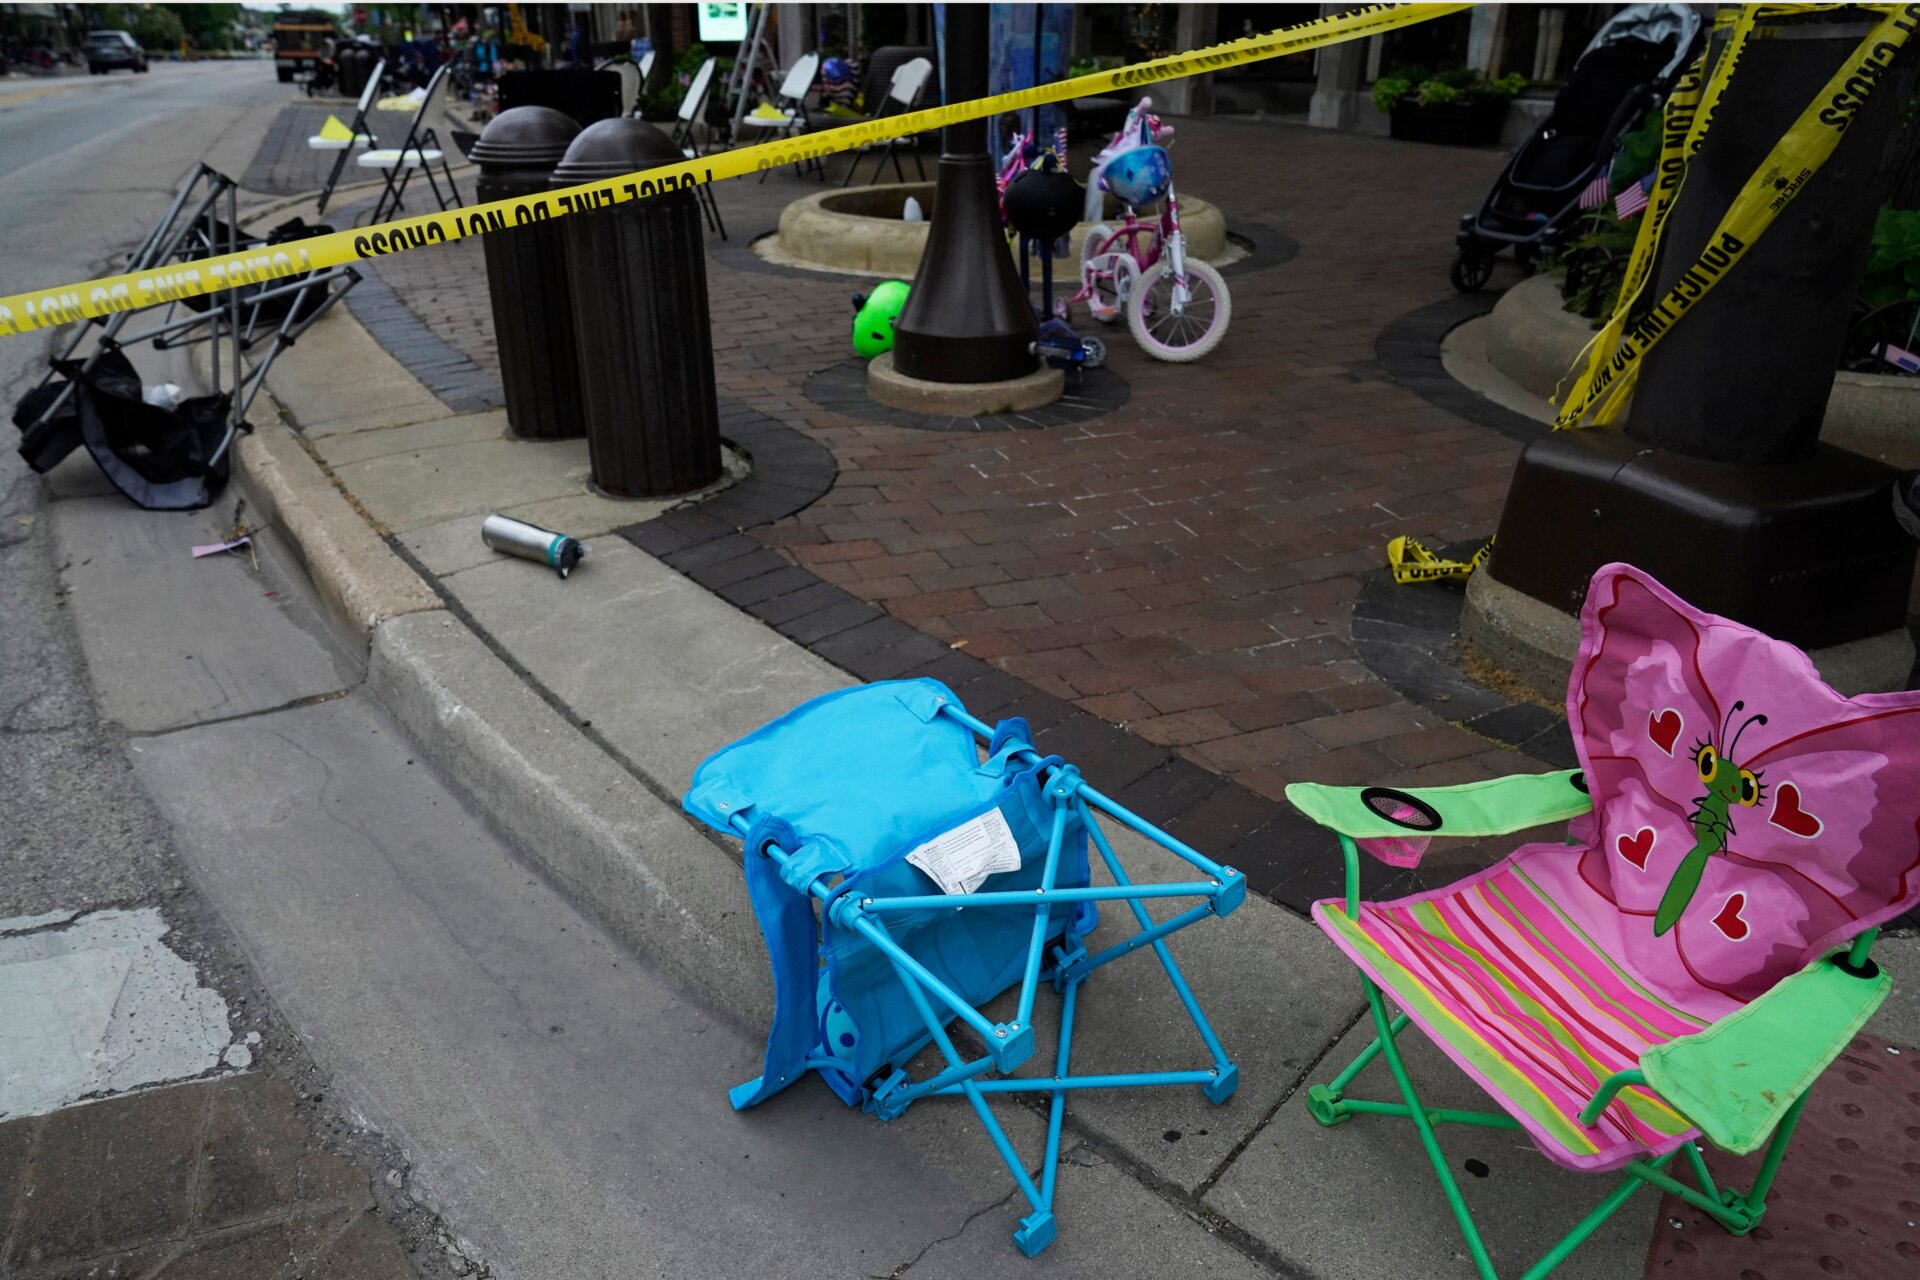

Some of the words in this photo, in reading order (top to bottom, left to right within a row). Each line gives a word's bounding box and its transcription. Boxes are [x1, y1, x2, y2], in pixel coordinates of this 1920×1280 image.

[1665, 102, 1696, 146] NOT
[1769, 168, 1810, 213] SIRCHIE
[137, 270, 203, 305] LINE
[1667, 231, 1744, 309] POLICE
